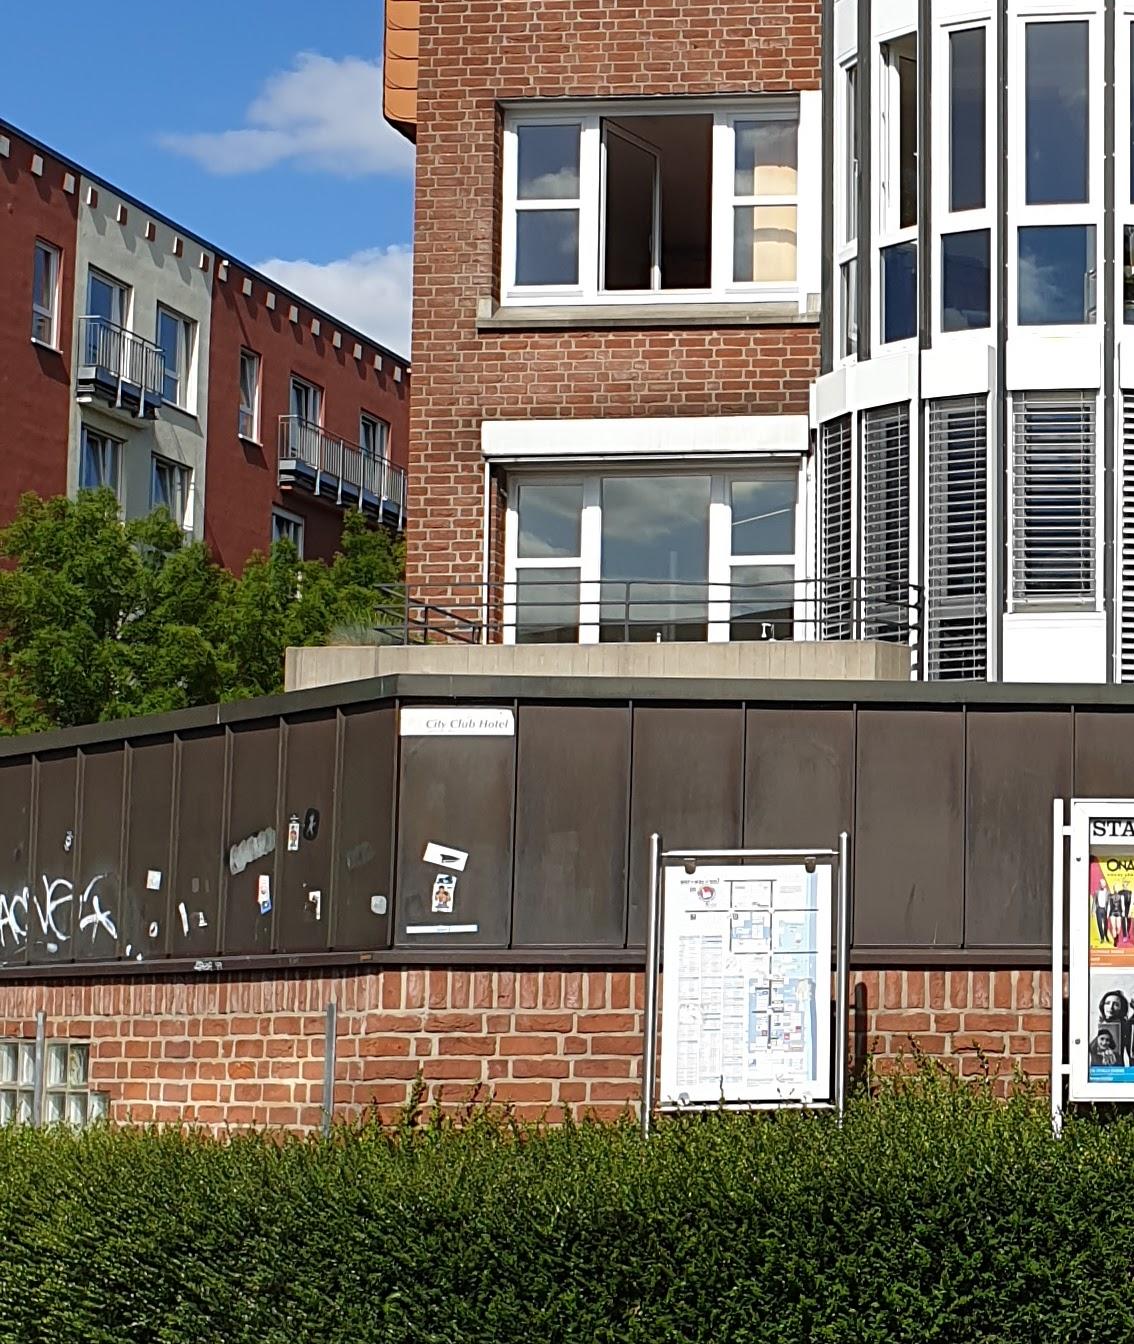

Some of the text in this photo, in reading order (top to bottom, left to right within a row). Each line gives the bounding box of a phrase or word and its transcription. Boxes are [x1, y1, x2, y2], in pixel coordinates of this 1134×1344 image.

[425, 719, 509, 729] City Club Hotel
